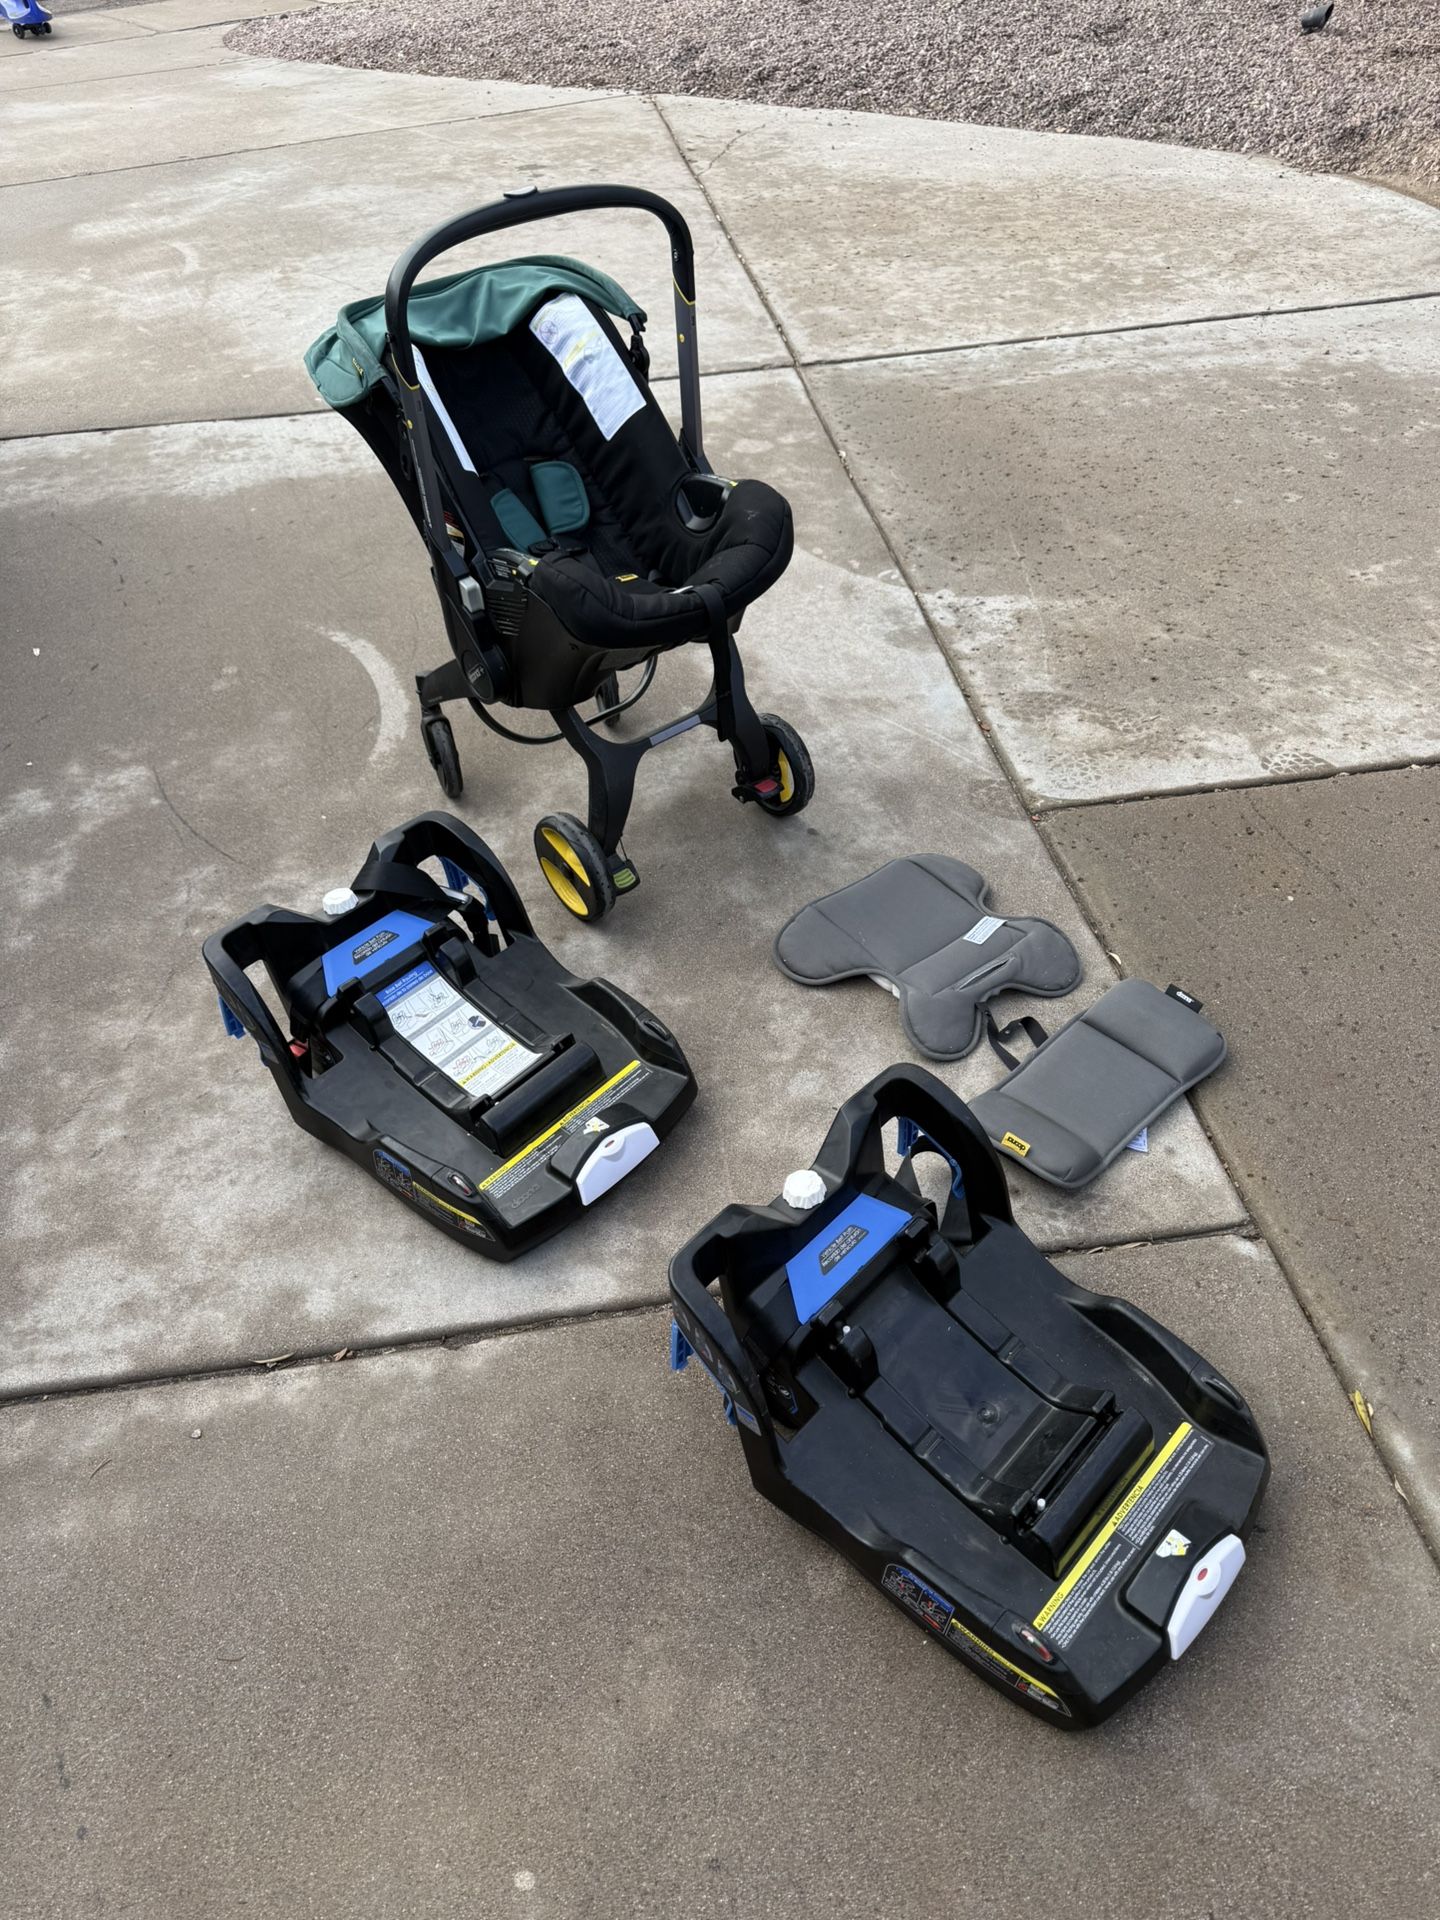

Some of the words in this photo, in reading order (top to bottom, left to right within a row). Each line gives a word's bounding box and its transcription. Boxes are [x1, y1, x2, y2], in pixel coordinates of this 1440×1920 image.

[1006, 1136, 1026, 1151] doona
[1115, 1485, 1144, 1520] ADVERTENCIA
[1040, 1592, 1064, 1623] WARNING
